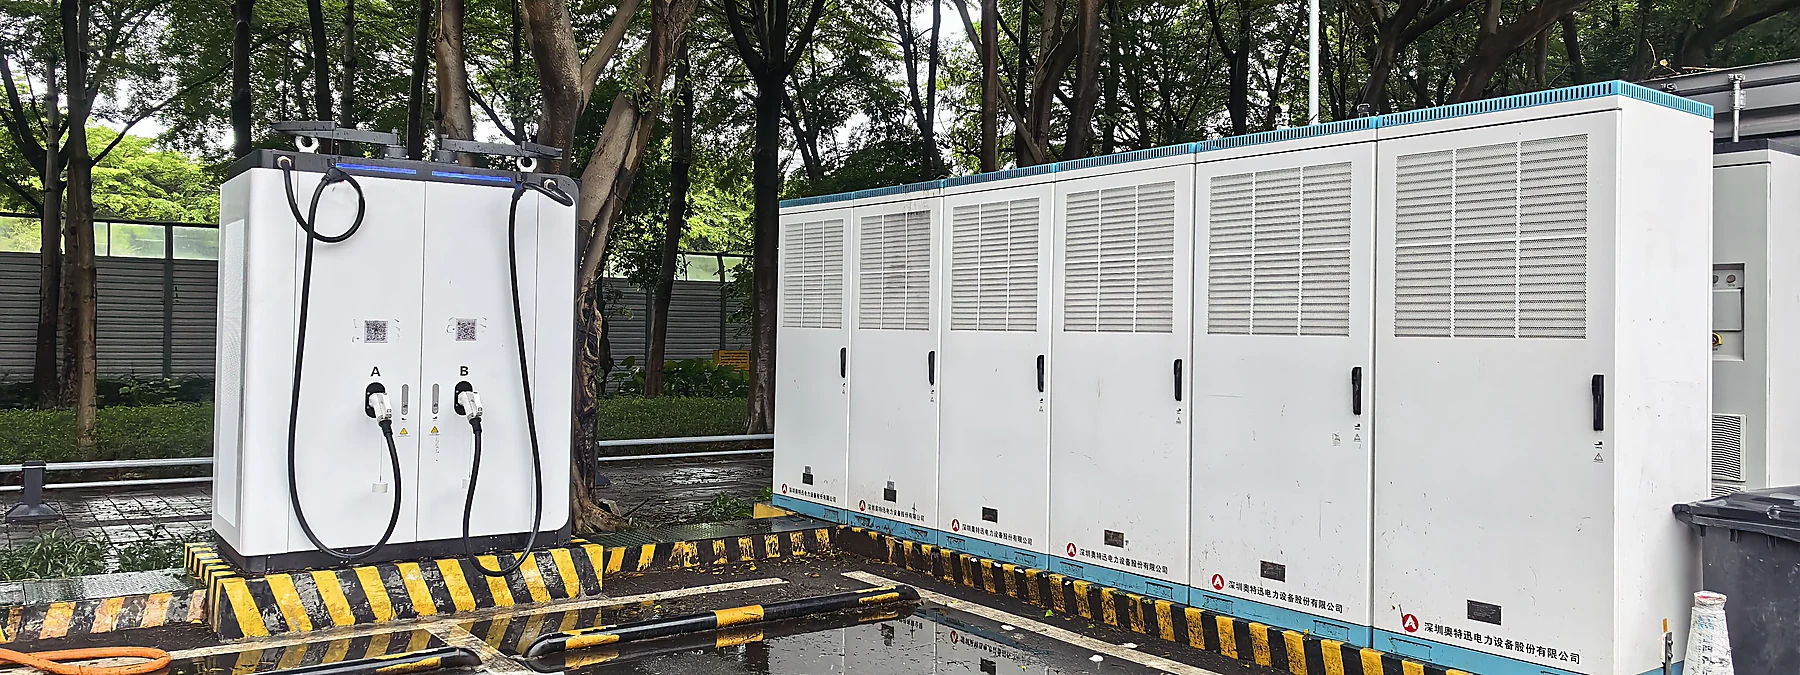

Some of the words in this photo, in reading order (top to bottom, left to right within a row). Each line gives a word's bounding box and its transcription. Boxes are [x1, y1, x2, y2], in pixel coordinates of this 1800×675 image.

[370, 366, 381, 377] A
[460, 366, 469, 376] B
[1079, 548, 1168, 574] 深圳奥特迅电力设备股份有限公司
[1228, 580, 1343, 613] 深圳奥特迅电力设备股份有限公司
[1424, 622, 1580, 664] 深圳奥特迅电力设备股份有限公司
